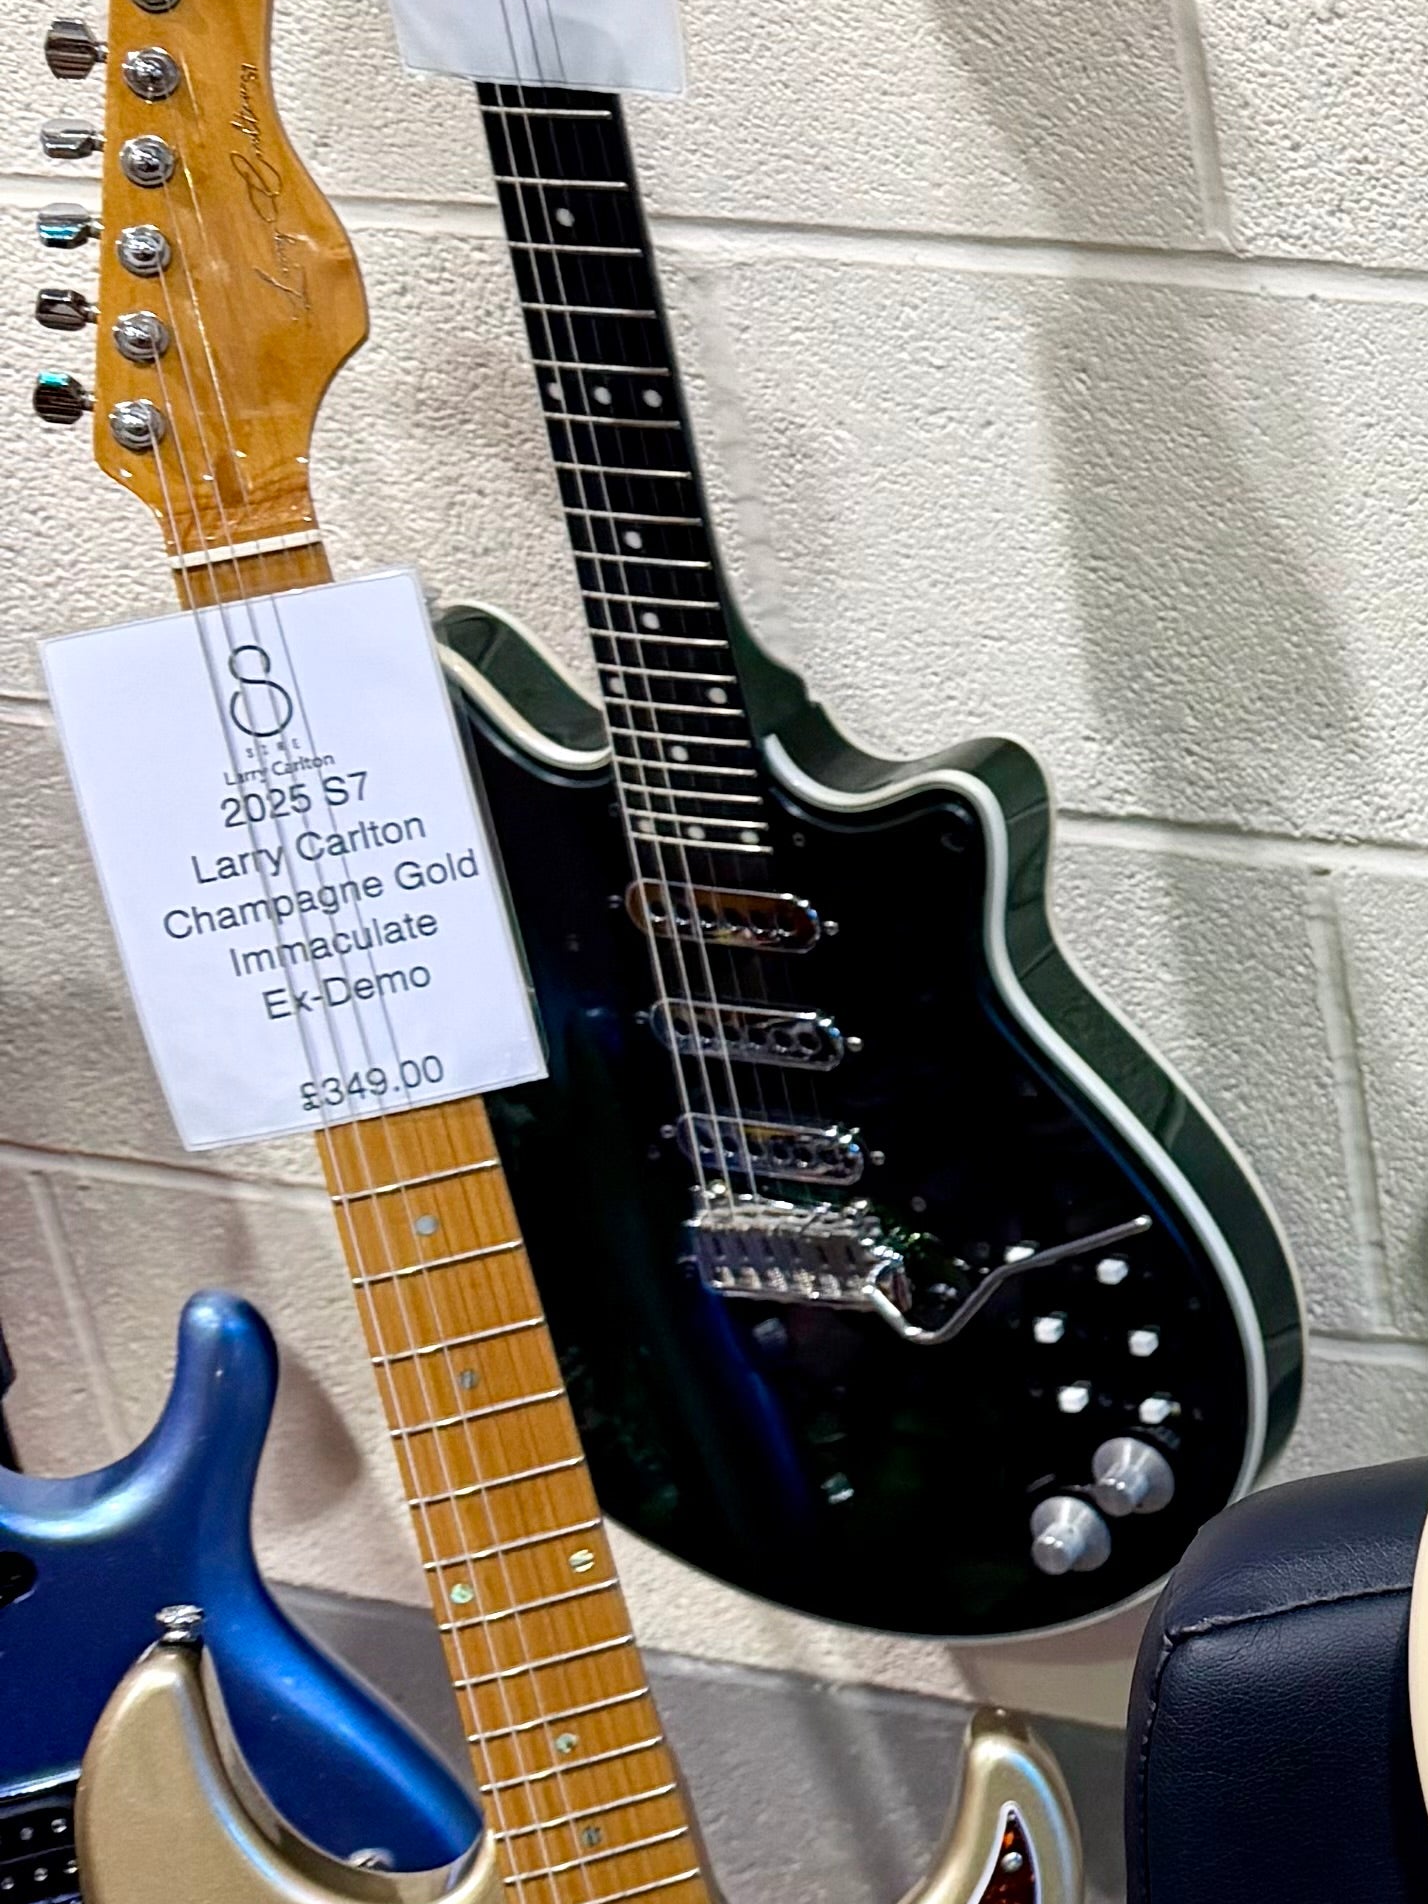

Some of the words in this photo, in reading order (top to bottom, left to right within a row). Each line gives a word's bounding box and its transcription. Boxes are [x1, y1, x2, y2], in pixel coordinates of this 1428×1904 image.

[222, 768, 269, 786] Larry
[271, 754, 336, 777] Carlton
[221, 786, 312, 829] 2025
[323, 772, 370, 809] S7
[192, 844, 286, 888] Larry
[295, 814, 427, 864] Carlton
[163, 881, 386, 941] Champagne
[395, 851, 480, 892] Gold
[230, 911, 439, 978] Immaculate
[262, 963, 431, 1021] Ex-Demo
[299, 1055, 446, 1112] £349.00
